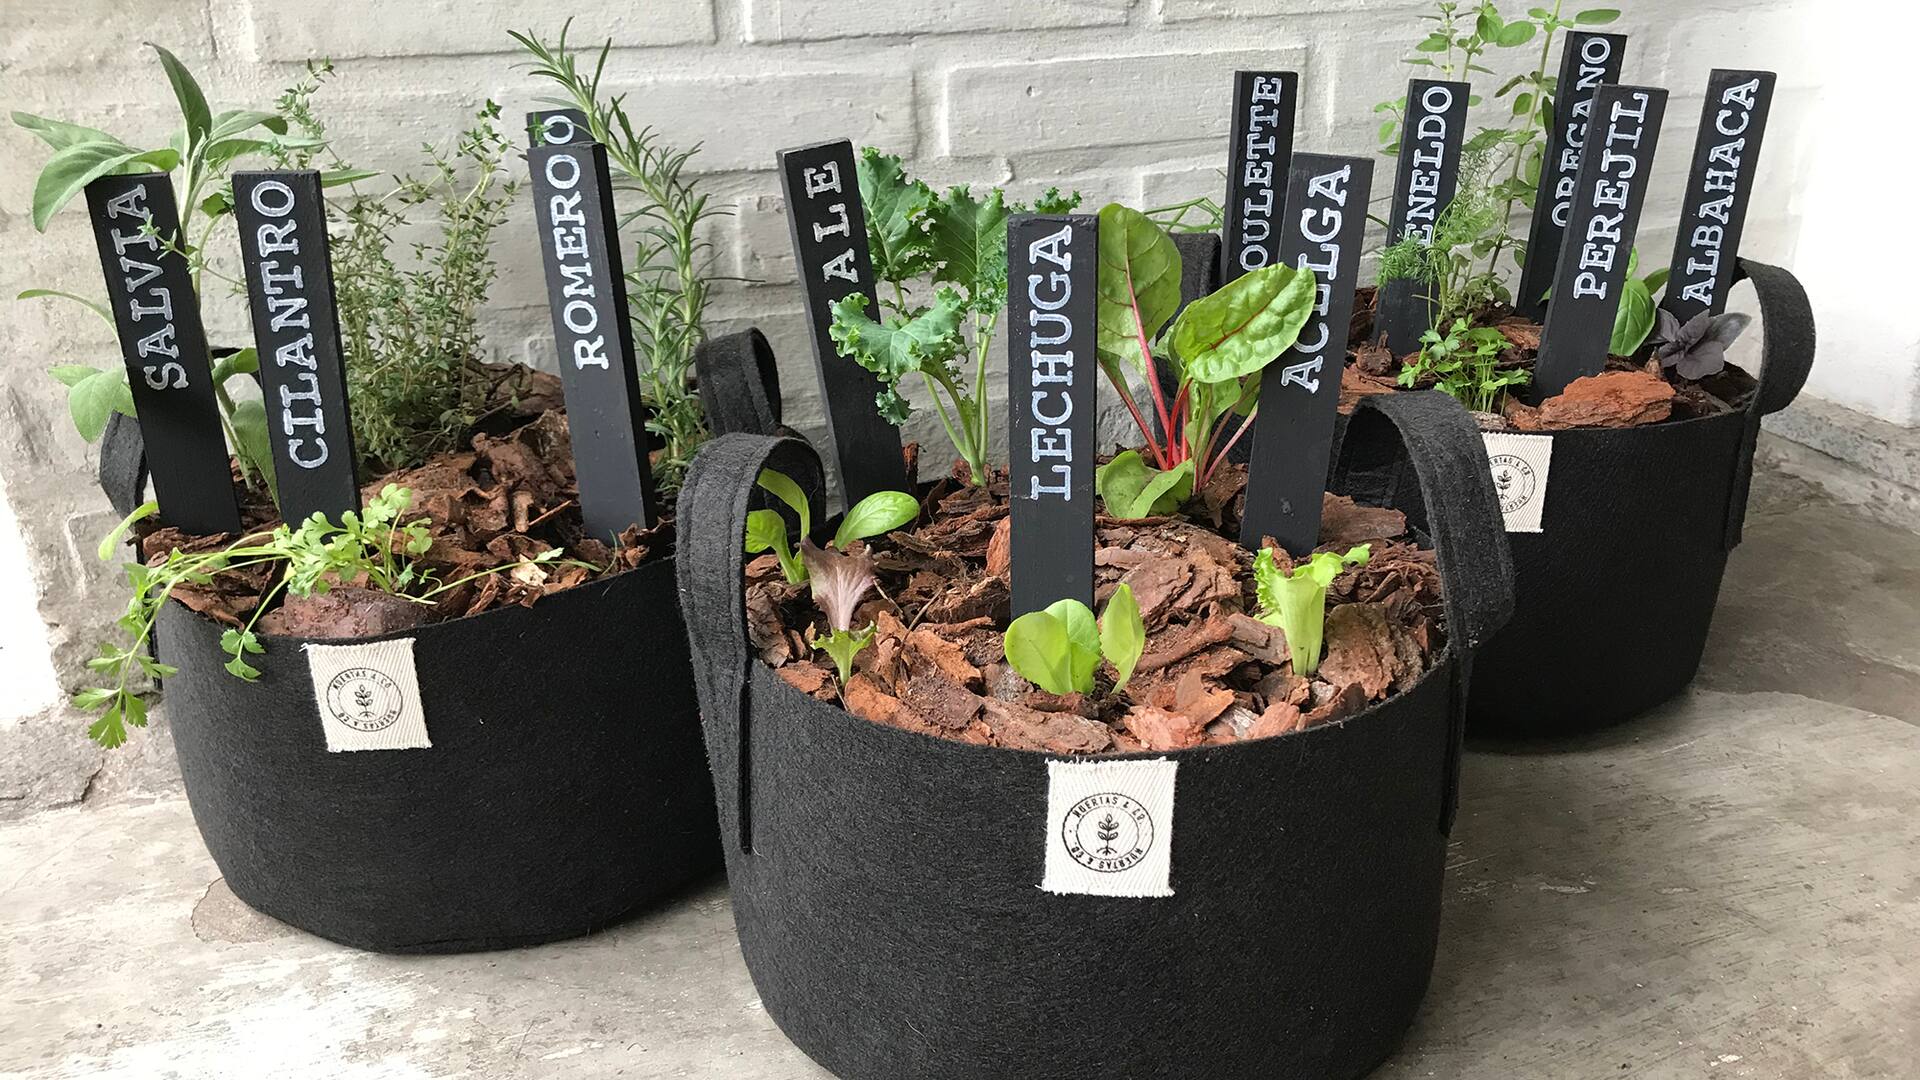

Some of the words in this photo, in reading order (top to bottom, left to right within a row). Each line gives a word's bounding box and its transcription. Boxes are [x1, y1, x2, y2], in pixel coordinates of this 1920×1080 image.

[545, 154, 610, 371] ROMERO
[803, 160, 860, 324] ALE
[1239, 76, 1283, 272] OULETTE
[1572, 91, 1649, 301] PEREJIL
[1682, 77, 1761, 306] ALBAHACA
[107, 183, 189, 391] SALVIA
[251, 180, 329, 469] CILANTRO
[1029, 224, 1073, 501] LECHUGA
[332, 670, 366, 690] HUERTAS
[1071, 795, 1119, 818] HUERTAS
[1123, 801, 1130, 809] &
[1087, 856, 1094, 865] &
[1098, 847, 1144, 870] HUERTAS
